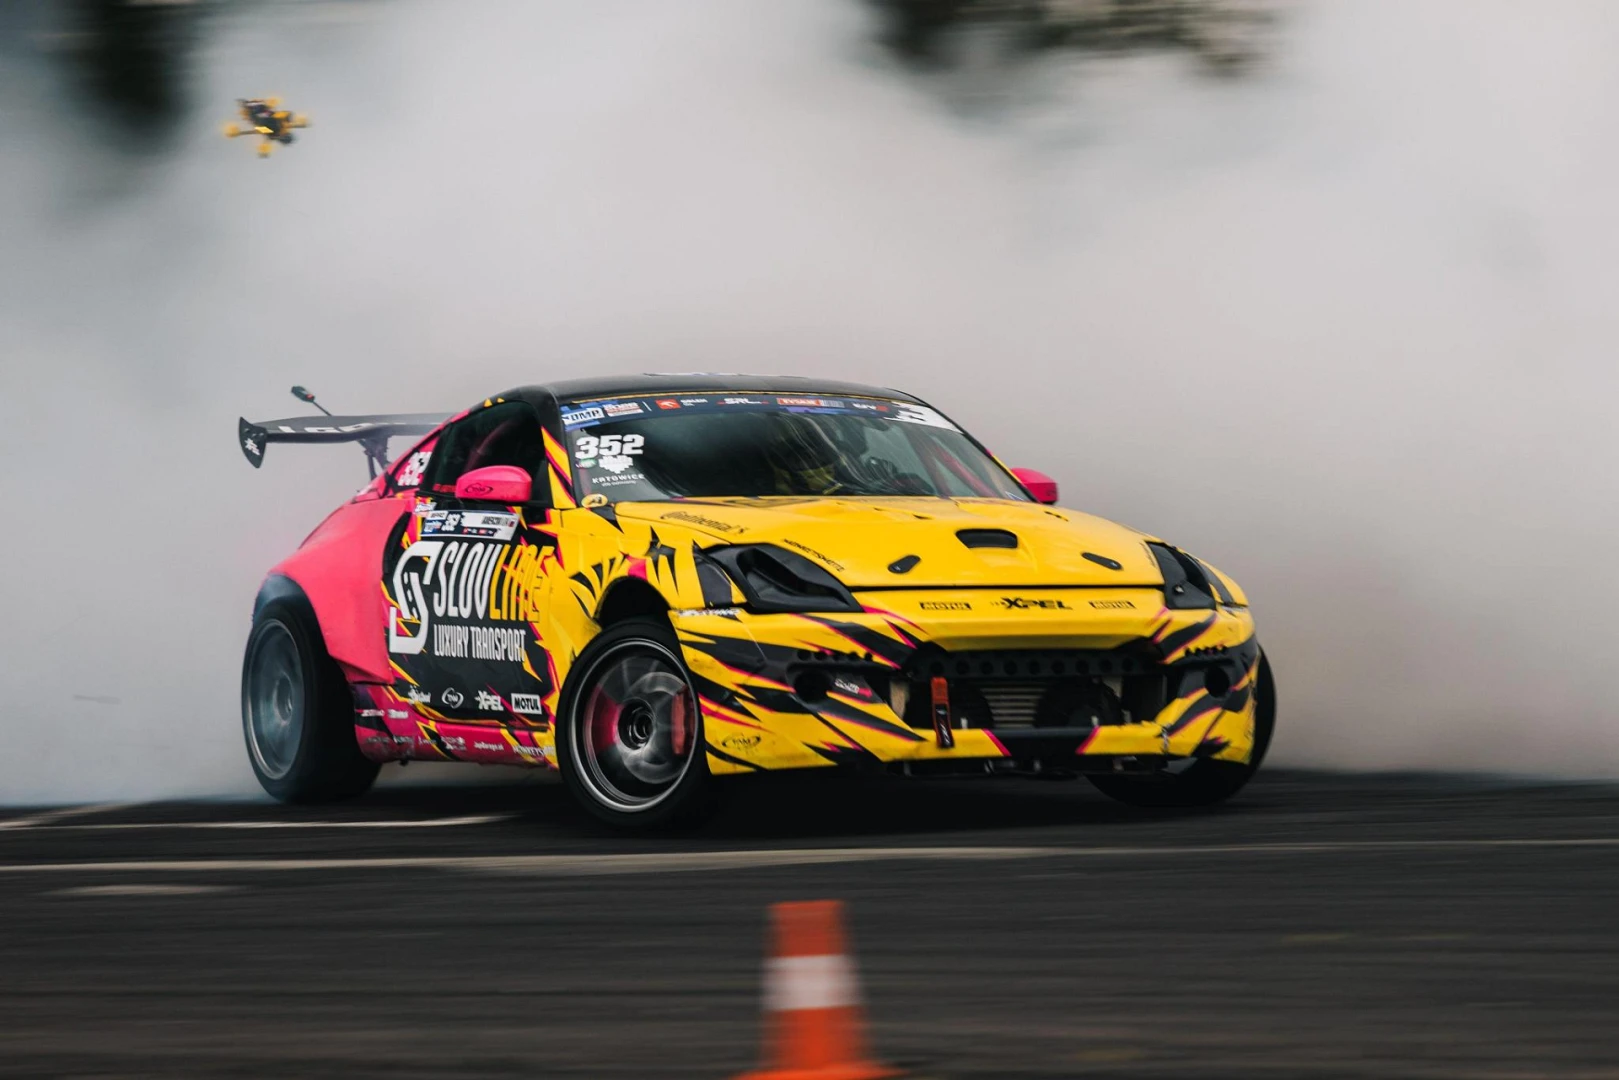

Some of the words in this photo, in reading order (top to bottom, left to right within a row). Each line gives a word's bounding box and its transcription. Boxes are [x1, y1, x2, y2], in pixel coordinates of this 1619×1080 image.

[575, 434, 645, 460] 352
[592, 473, 645, 484] KATOWICE
[1001, 597, 1073, 610] XPEL
[433, 624, 469, 659] LUXURY
[470, 626, 526, 662] TRANSPORT
[475, 690, 504, 711] XPEL
[514, 698, 540, 711] MOTUL
